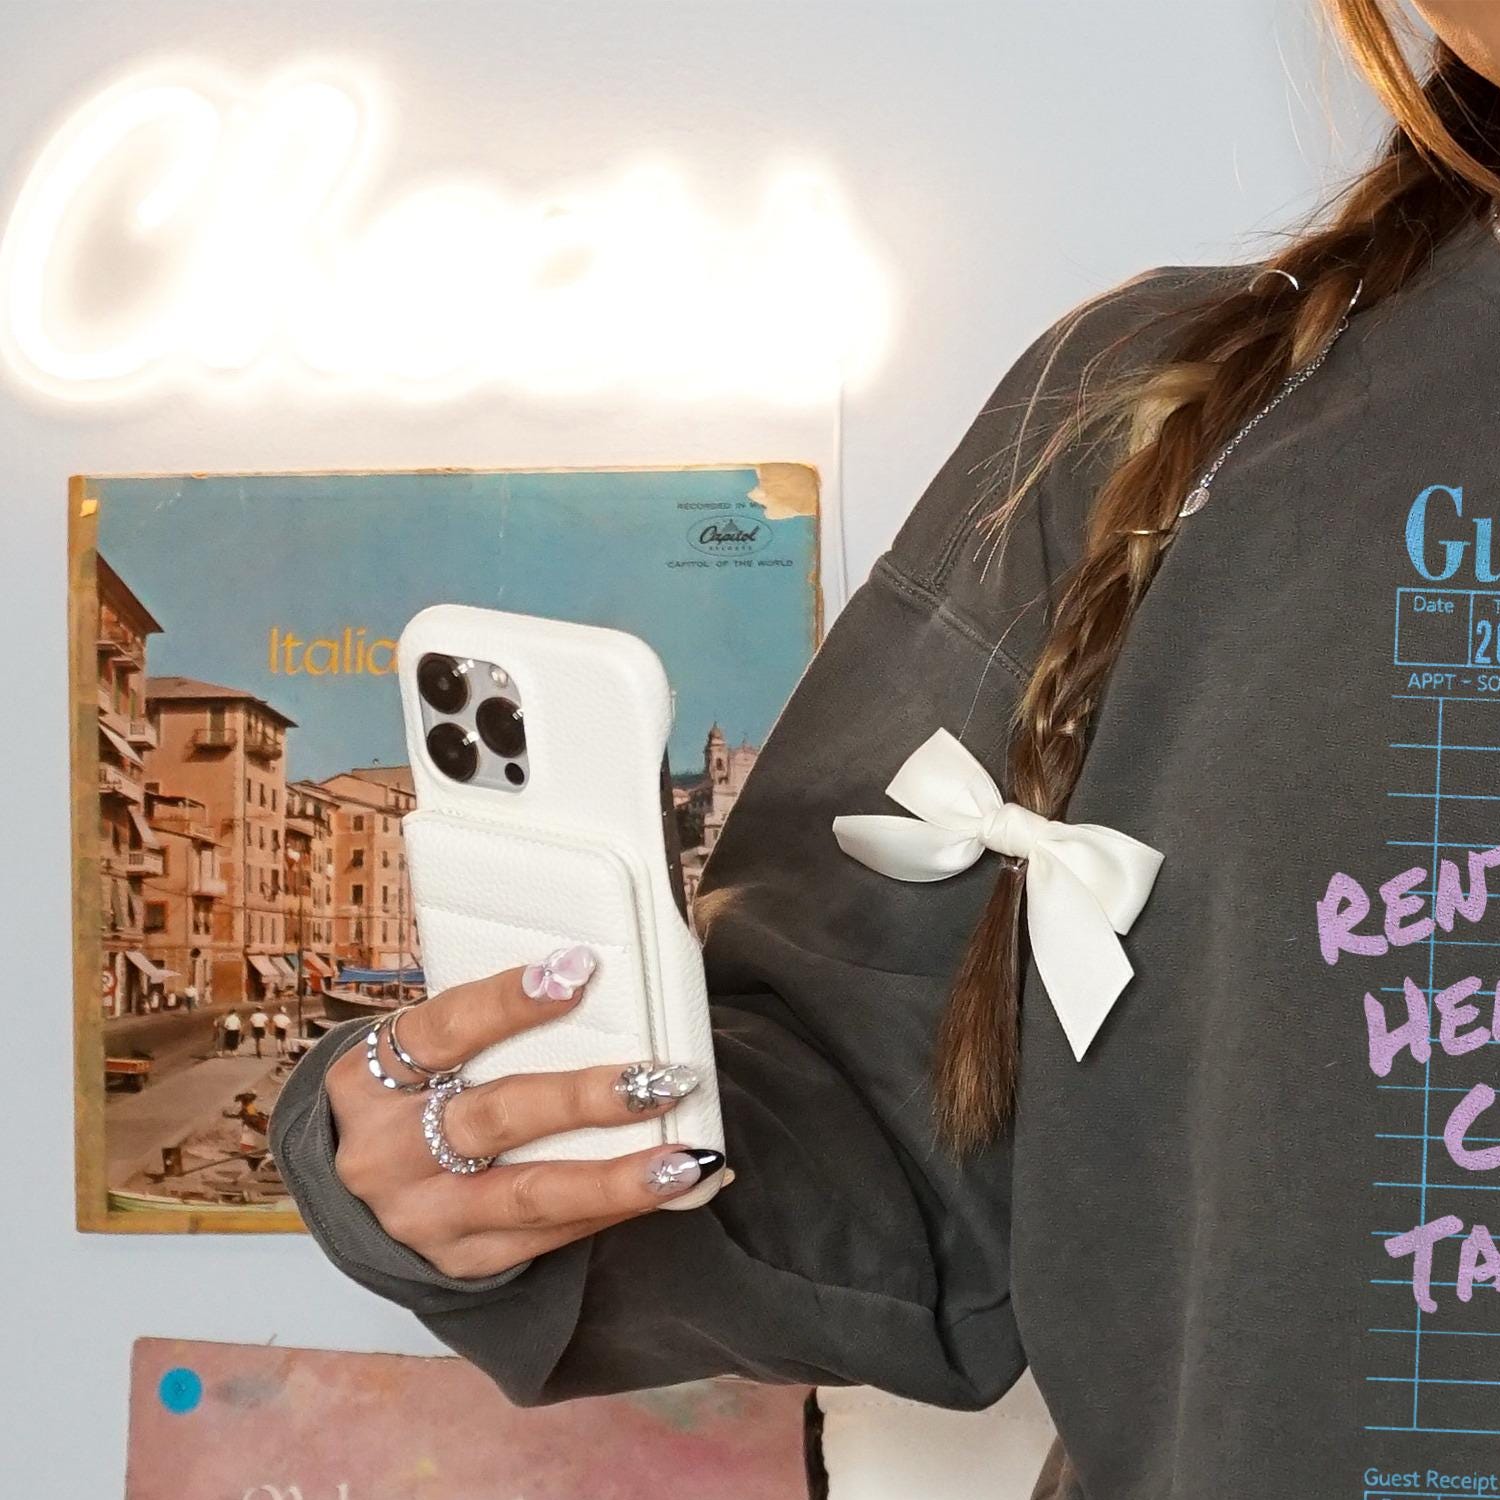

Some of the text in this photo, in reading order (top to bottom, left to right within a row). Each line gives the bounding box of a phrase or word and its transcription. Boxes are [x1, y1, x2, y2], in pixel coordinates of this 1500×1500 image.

[699, 525, 760, 545] Capitol
[1413, 595, 1455, 614] Date
[1407, 672, 1457, 690] APPT
[1364, 1468, 1499, 1495] Guest Receipt
